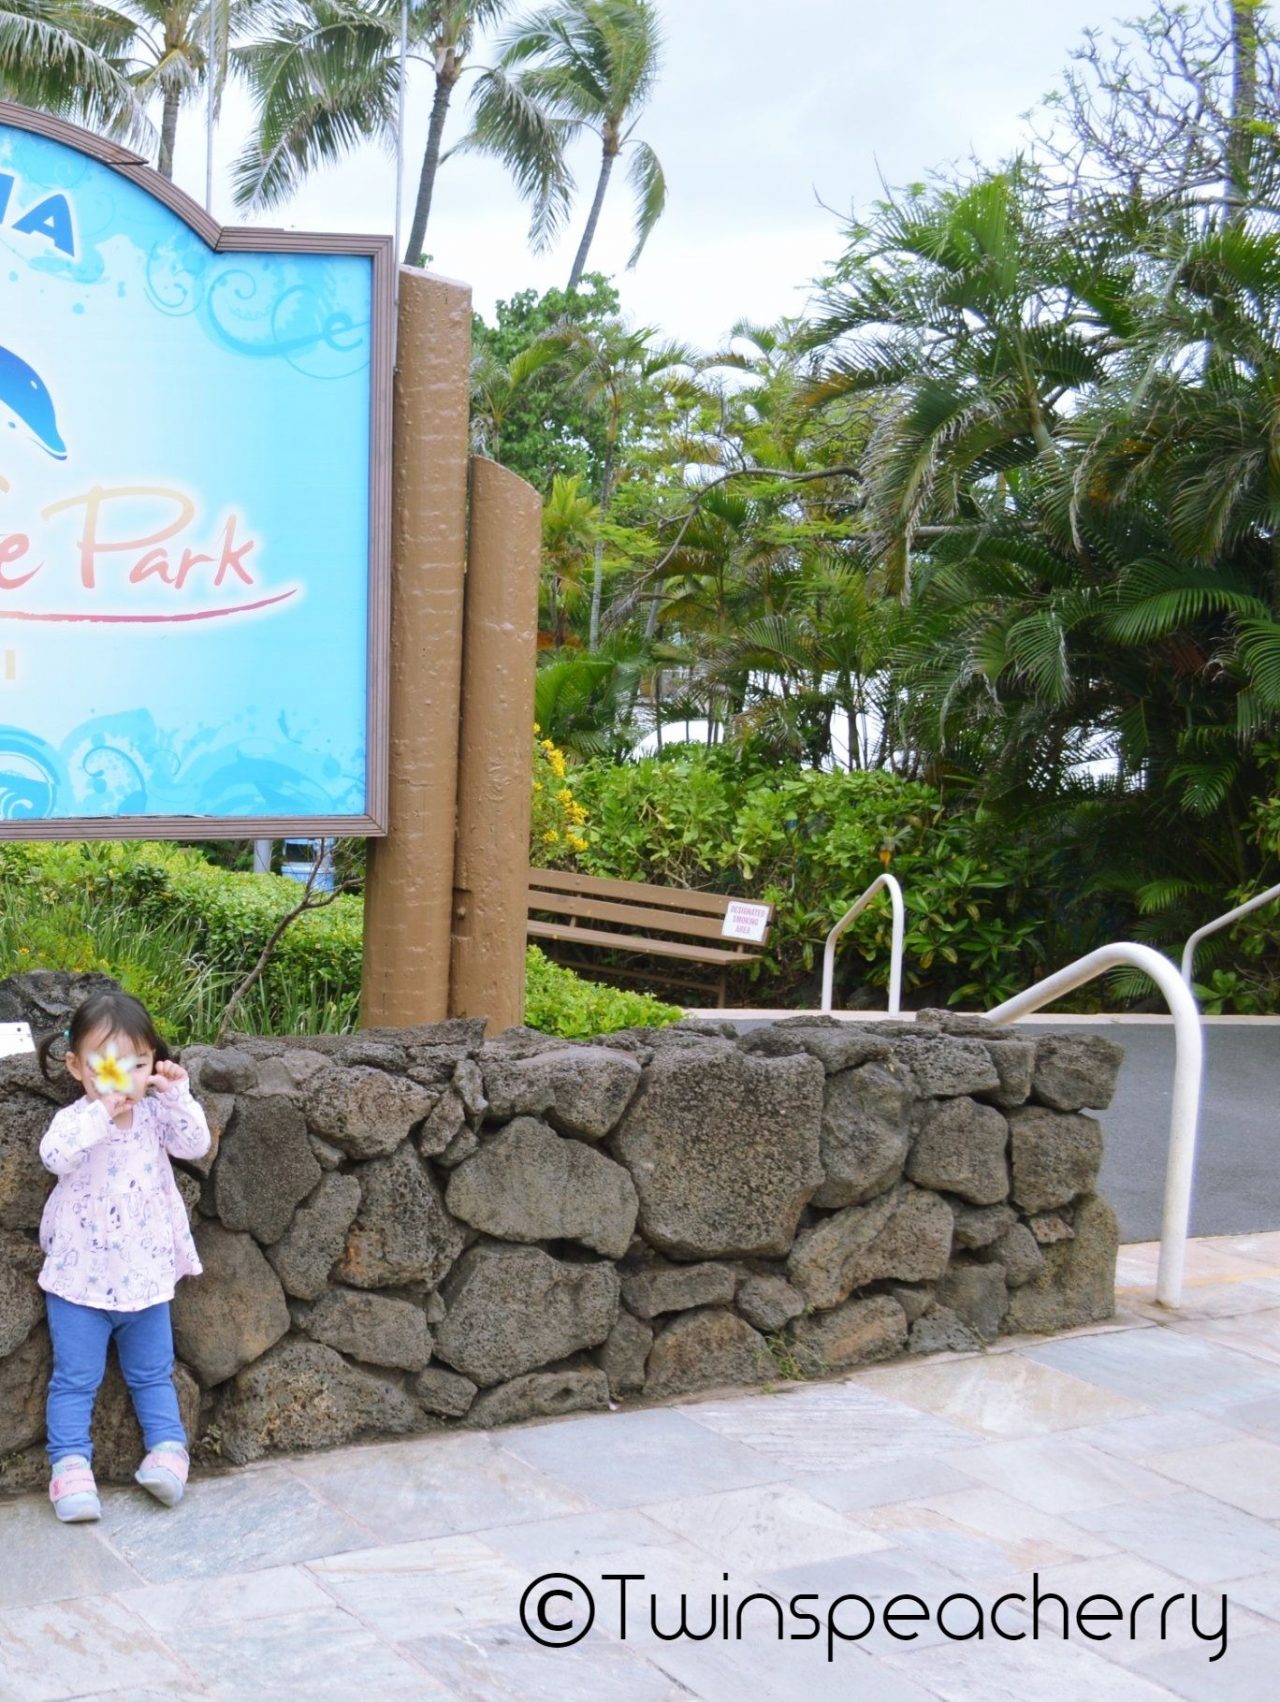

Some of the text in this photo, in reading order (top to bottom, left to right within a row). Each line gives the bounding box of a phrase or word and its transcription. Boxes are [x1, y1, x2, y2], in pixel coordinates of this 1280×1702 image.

[41, 485, 256, 589] Park
[730, 905, 766, 918] DESIGNATED
[732, 915, 759, 926] SMOKING
